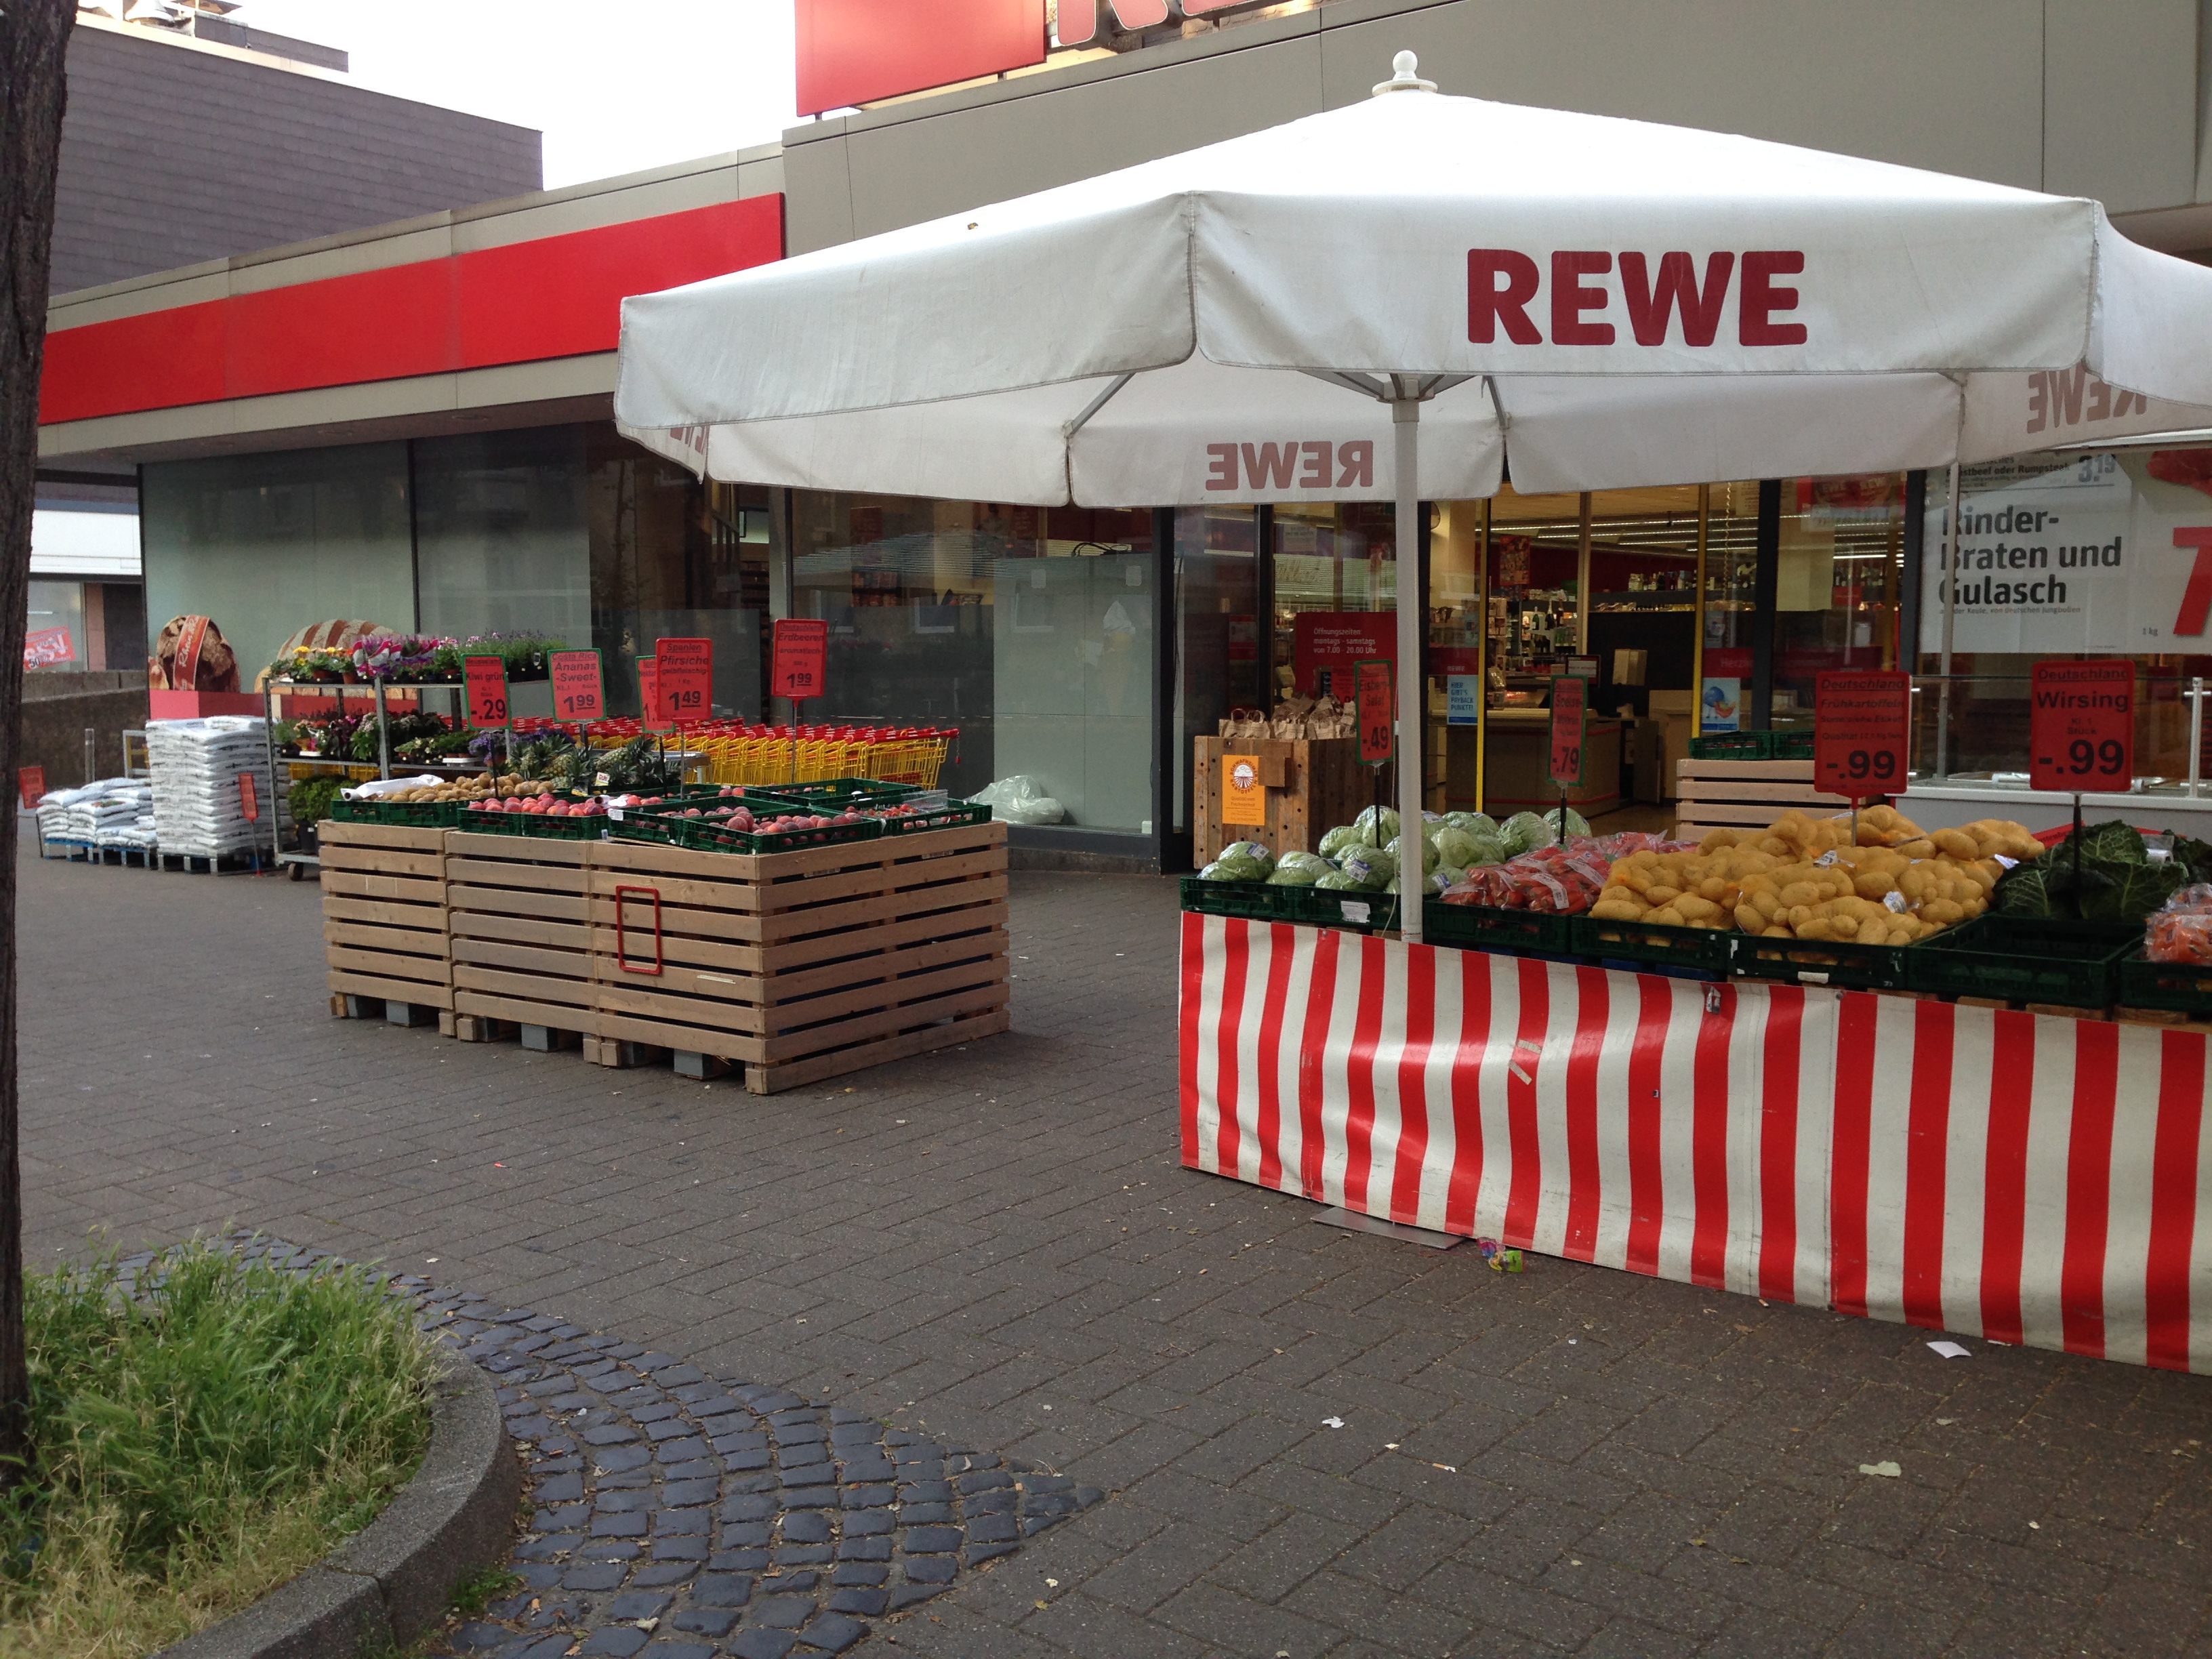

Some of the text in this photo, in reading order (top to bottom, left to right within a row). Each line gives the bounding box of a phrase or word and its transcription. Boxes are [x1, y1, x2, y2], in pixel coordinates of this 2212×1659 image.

[1467, 249, 1807, 346] REWE
[1994, 466, 2015, 474] oder
[2060, 536, 2122, 568] und
[1939, 574, 2066, 604] Gulasch
[2148, 627, 2158, 636] kg
[554, 662, 597, 671] Ananas
[660, 655, 709, 665] Pfirsiche
[1821, 678, 1904, 690] Deutschland
[2037, 691, 2129, 713] Wirsing
[1826, 750, 1896, 779] -.99
[2039, 739, 2125, 775] -.99
